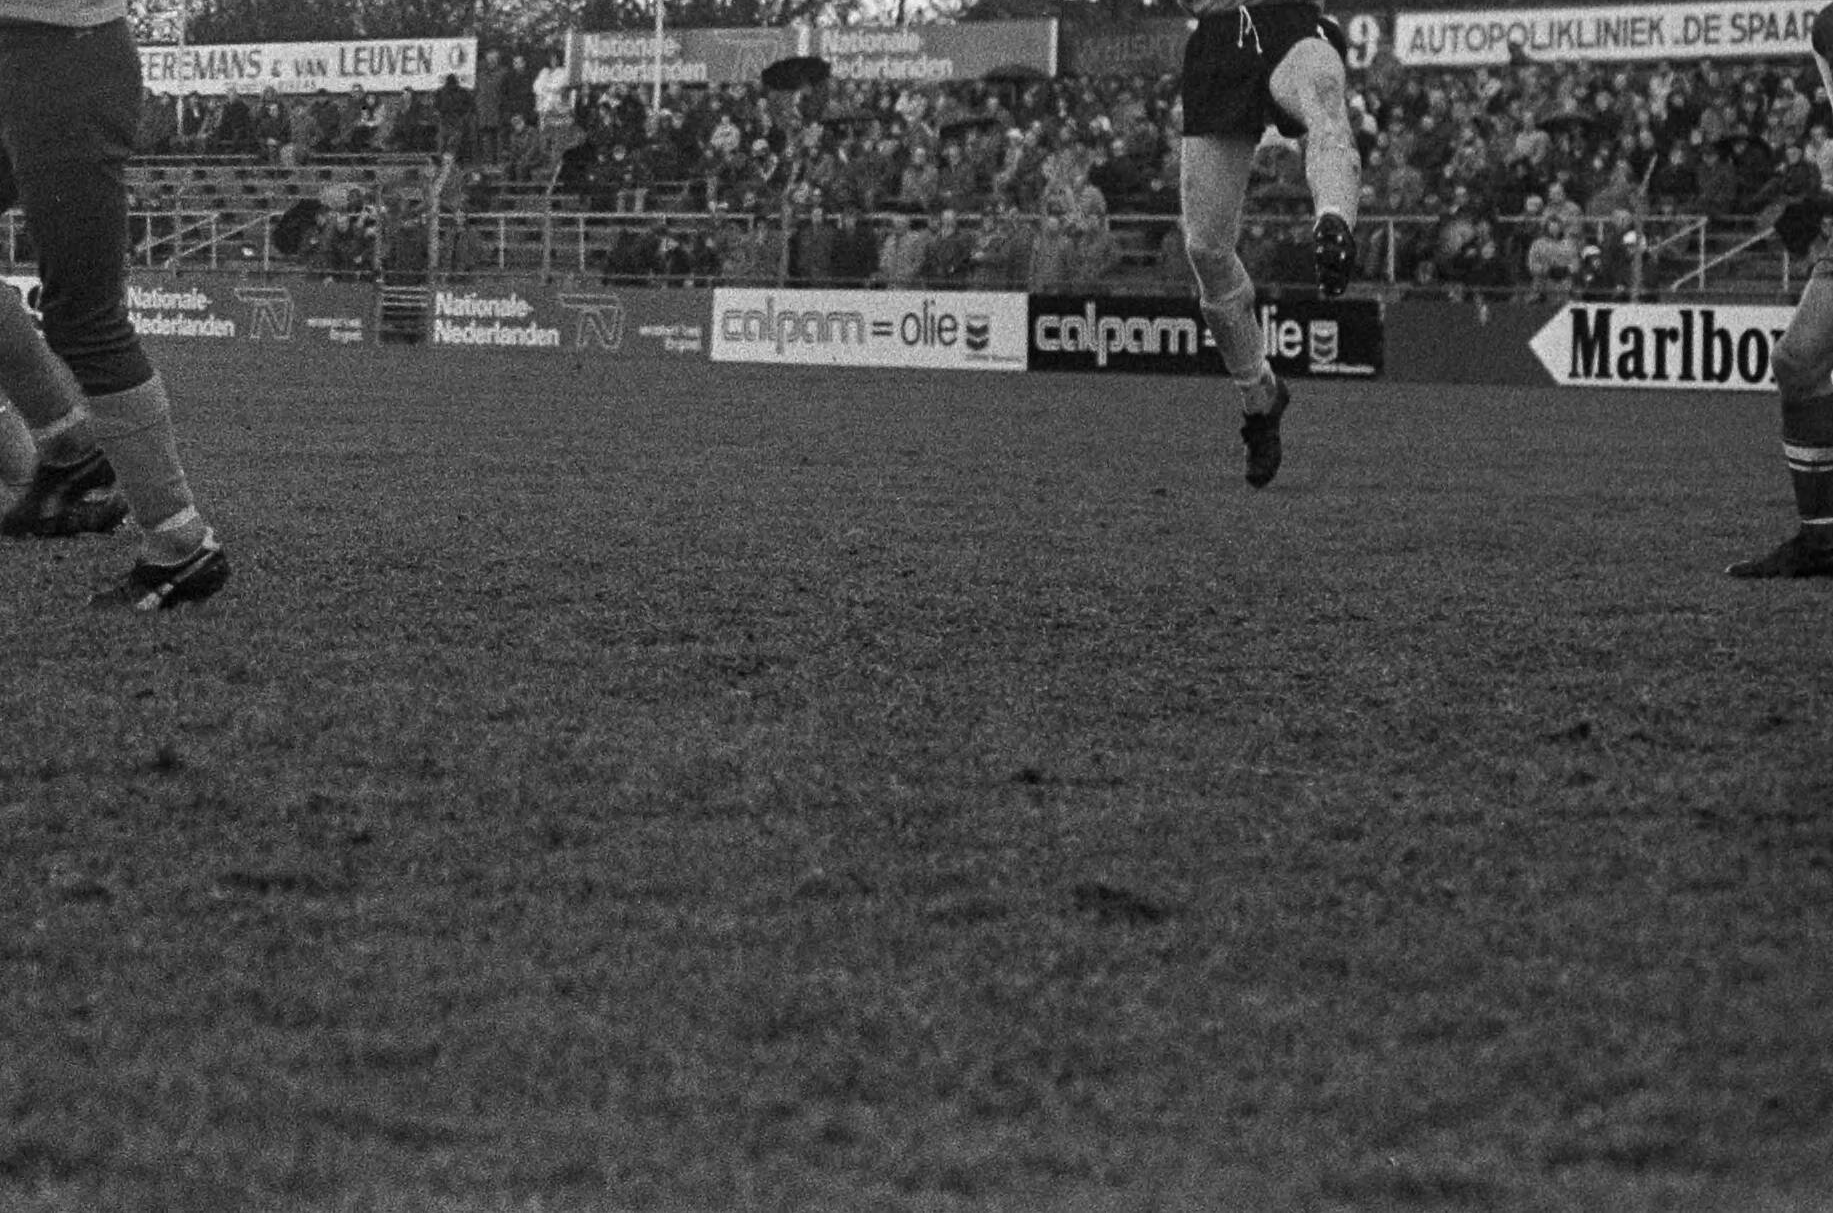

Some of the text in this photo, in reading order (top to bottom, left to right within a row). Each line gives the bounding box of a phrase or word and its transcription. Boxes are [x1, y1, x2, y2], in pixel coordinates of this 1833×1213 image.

[1410, 14, 1665, 54] AUTOPOLIKLINIEK
[140, 50, 262, 81] EREMANS
[338, 45, 430, 77] LEUVEN
[435, 292, 535, 317] Nationale-
[434, 319, 560, 347] Nederlanden
[722, 296, 866, 355] calpam
[901, 299, 958, 347] olie
[1035, 300, 1303, 367] calpam lie
